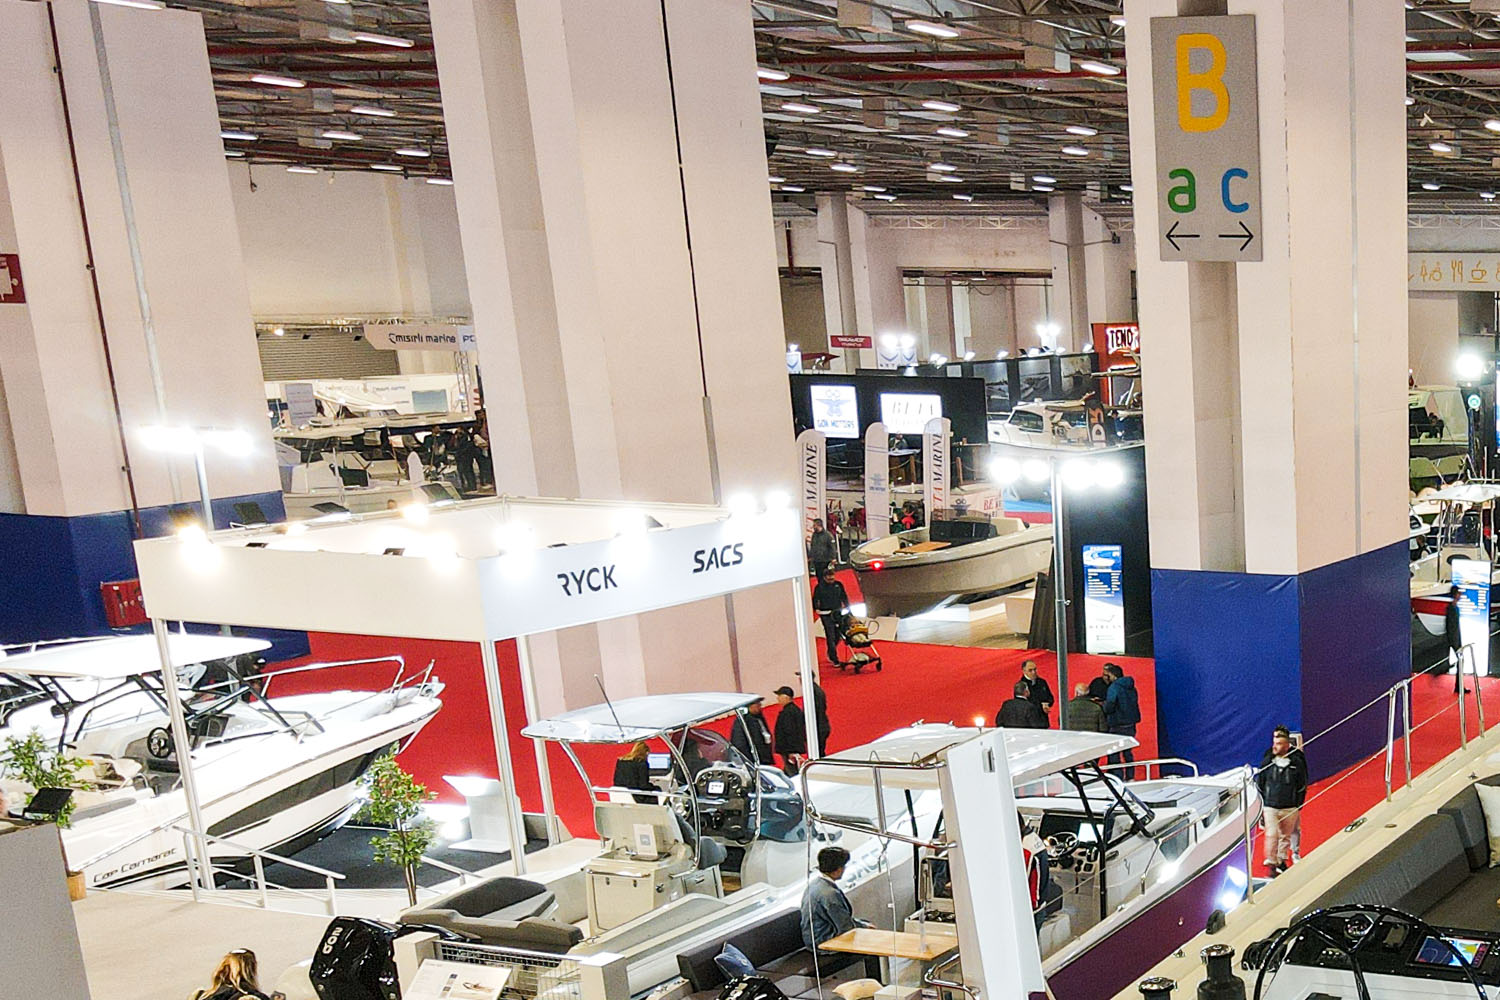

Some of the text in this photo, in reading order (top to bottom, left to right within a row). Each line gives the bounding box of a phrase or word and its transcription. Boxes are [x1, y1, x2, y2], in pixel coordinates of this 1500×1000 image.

[1176, 33, 1230, 133] B
[1167, 168, 1249, 213] a c
[806, 443, 818, 502] MARINE
[692, 542, 744, 573] SACS
[557, 564, 618, 596] RYCK
[121, 847, 177, 873] Camarat
